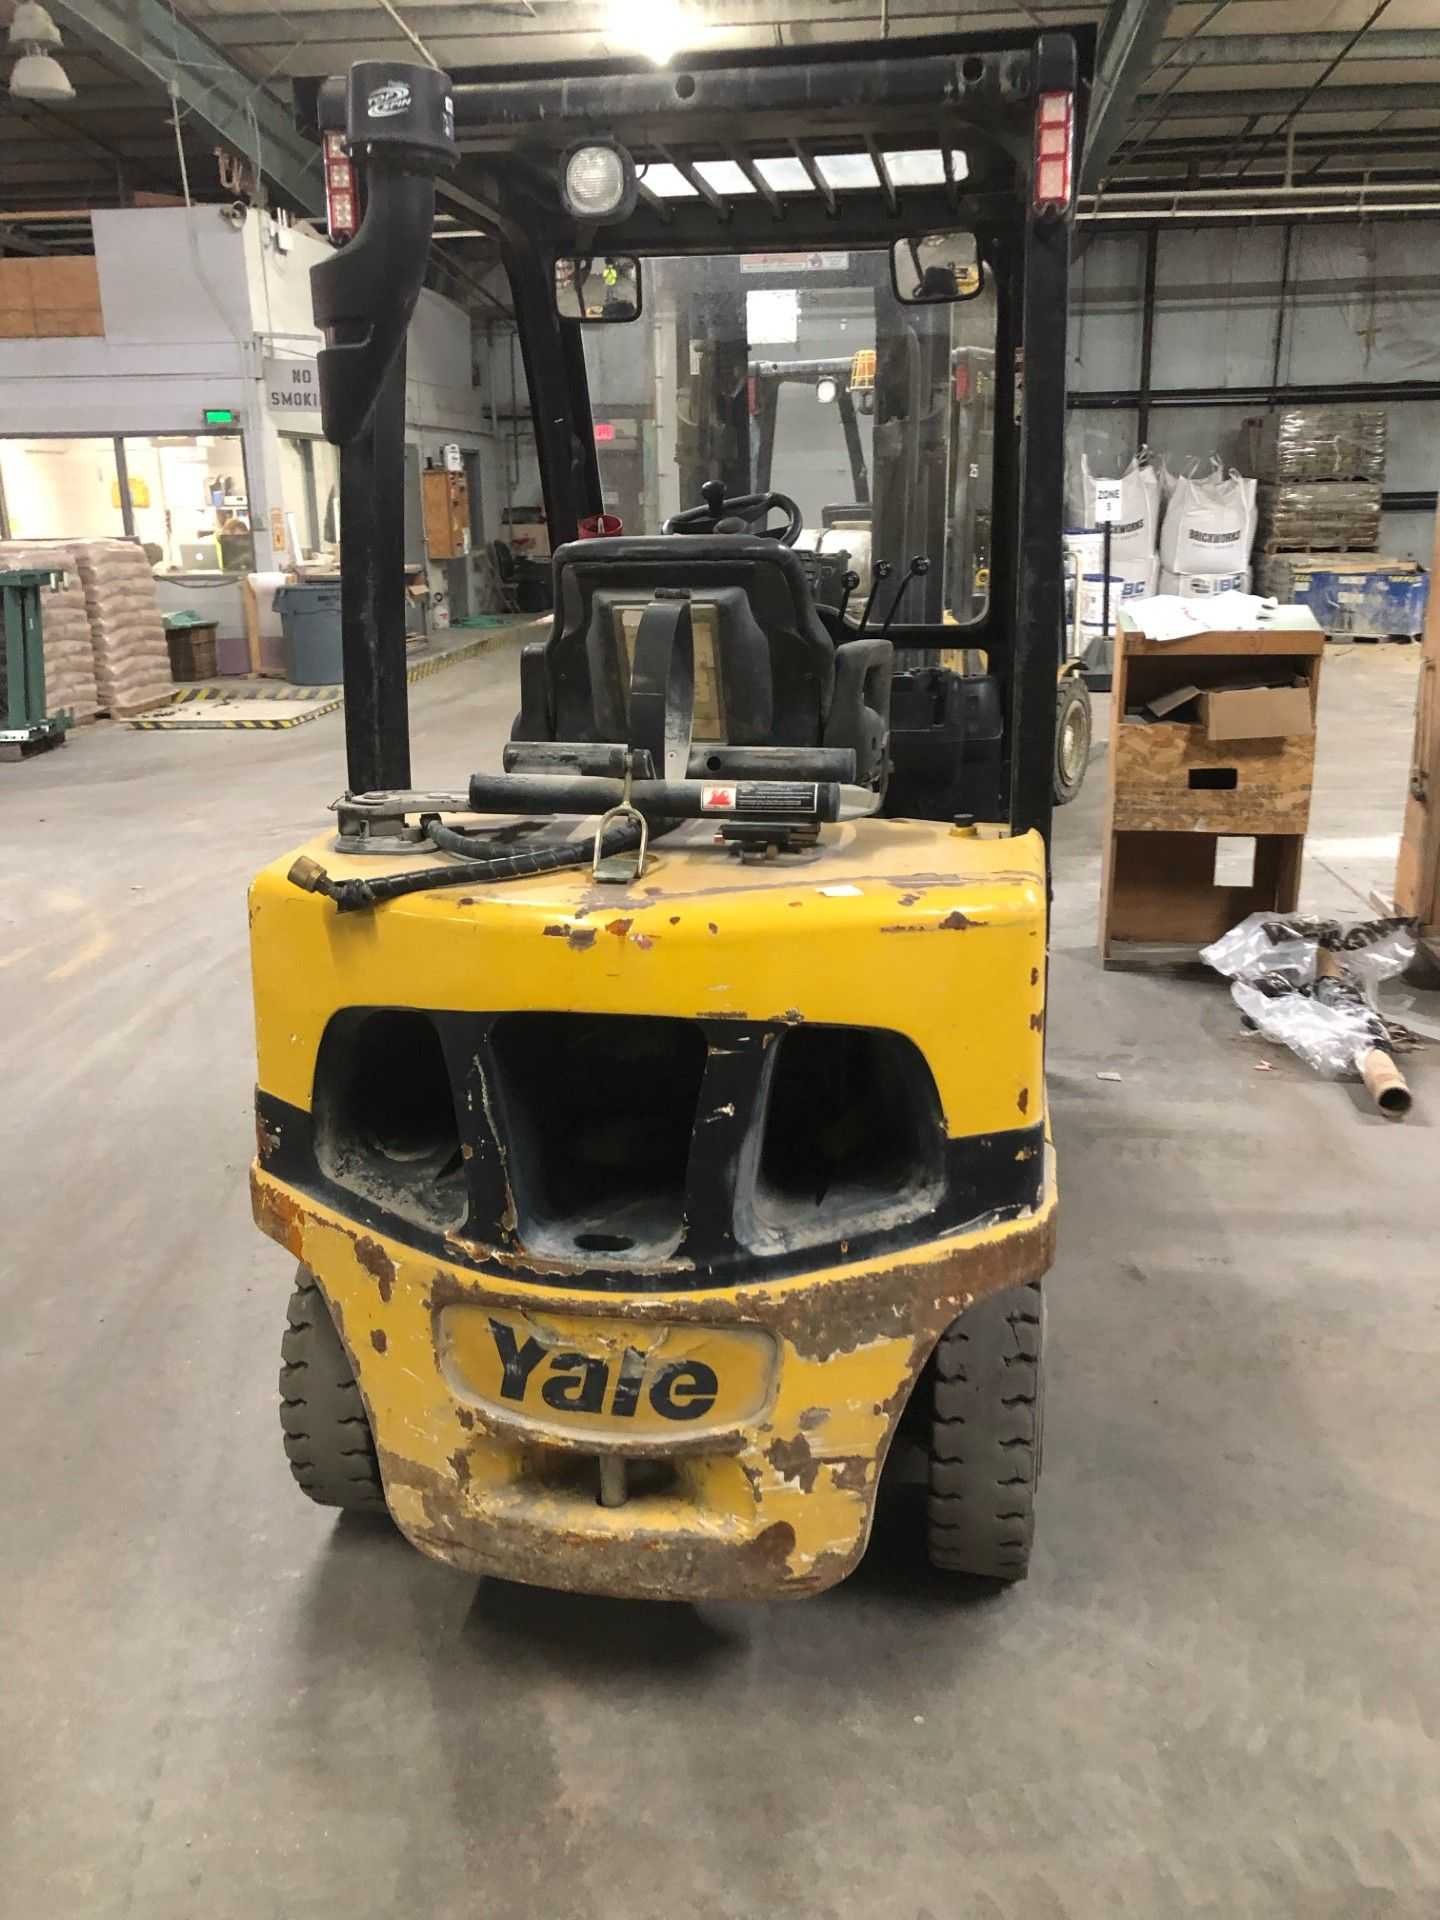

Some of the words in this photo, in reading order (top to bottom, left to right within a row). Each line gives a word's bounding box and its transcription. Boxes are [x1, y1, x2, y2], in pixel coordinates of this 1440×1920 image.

[292, 369, 311, 383] NO
[271, 392, 318, 407] SMOKI
[1098, 489, 1120, 499] ZONE
[1189, 528, 1241, 544] BRICKWORKS
[1121, 581, 1145, 596] BC
[488, 1317, 718, 1420] Yale
